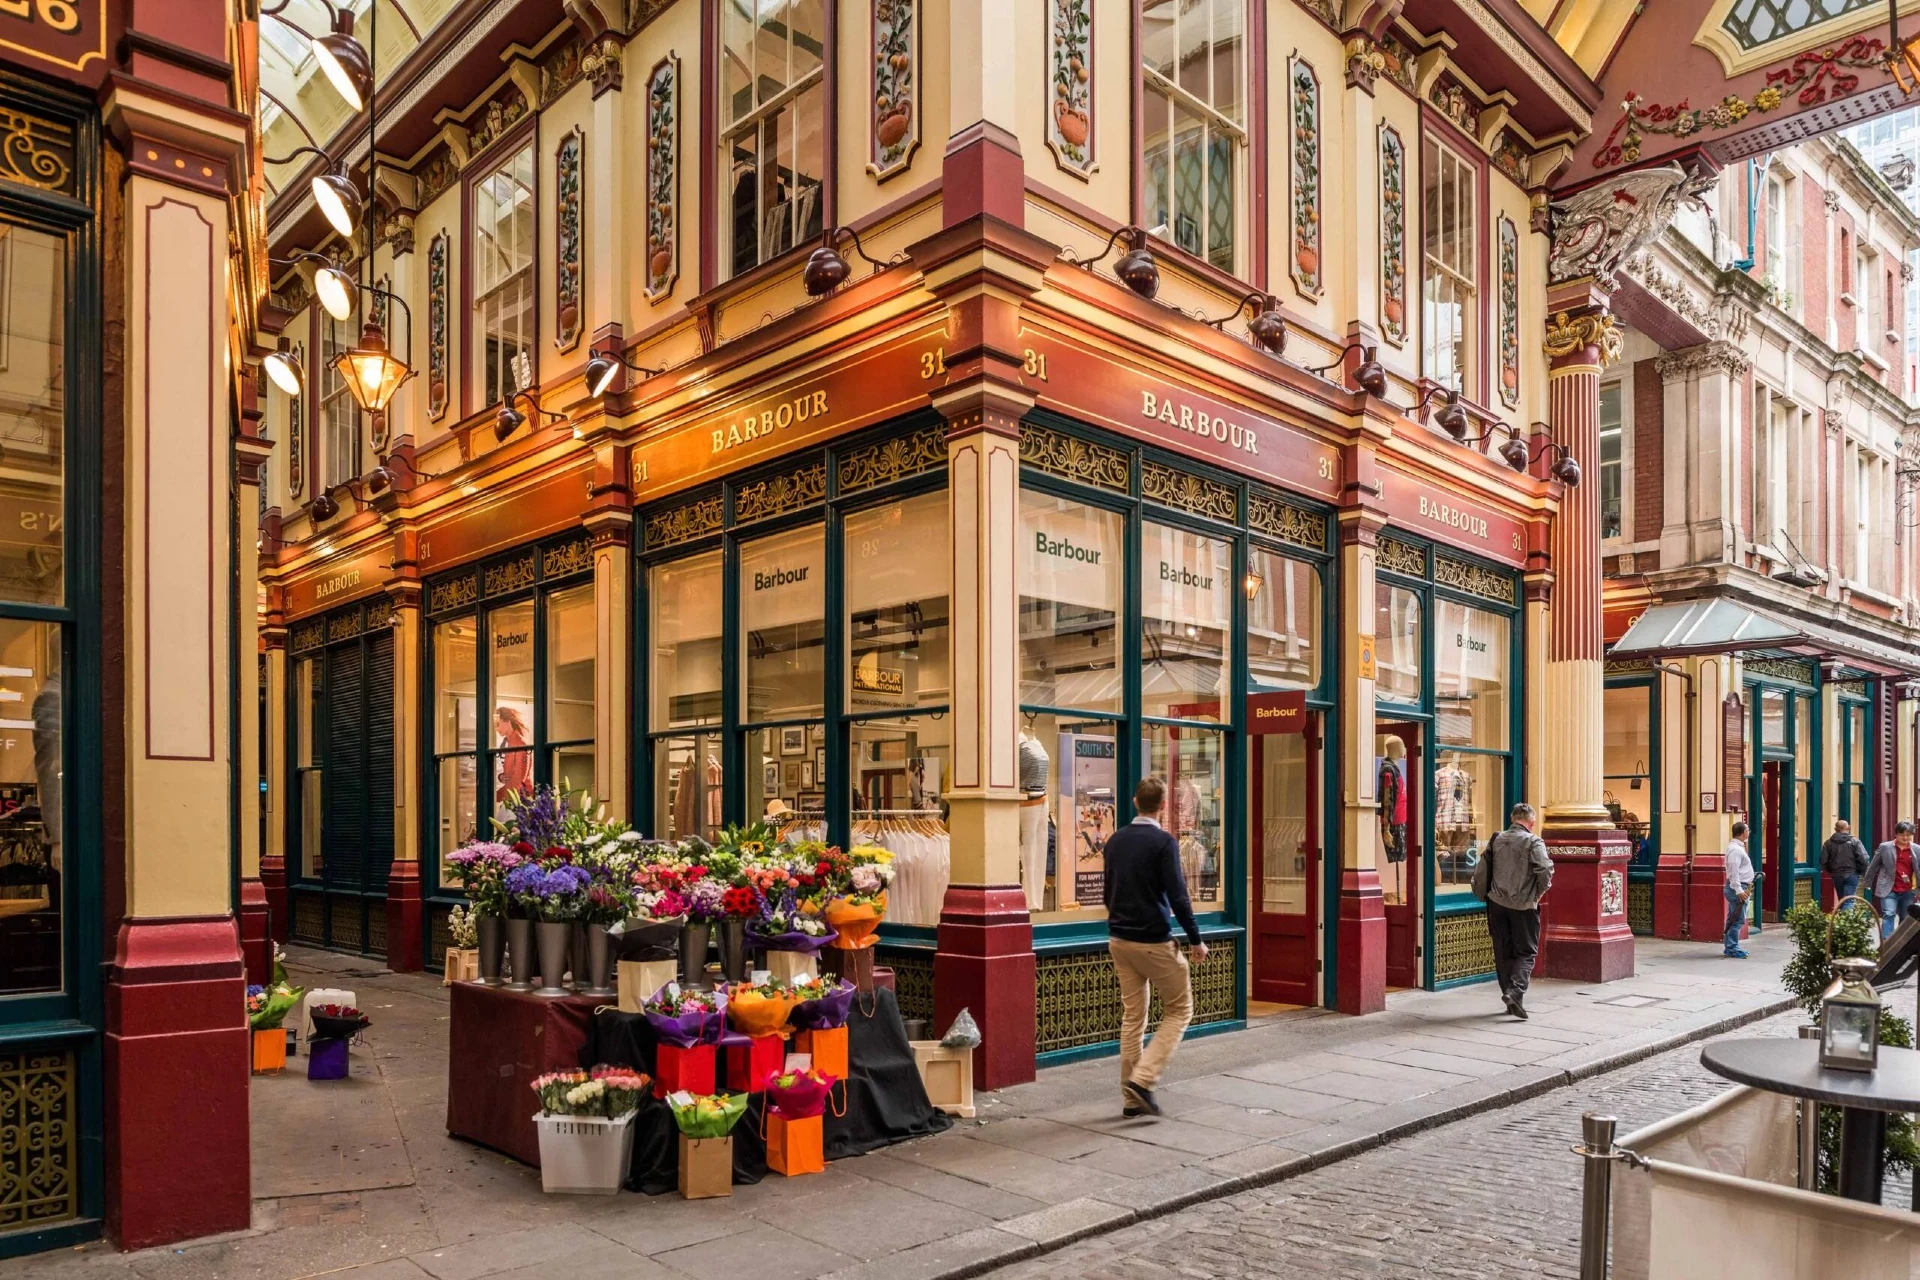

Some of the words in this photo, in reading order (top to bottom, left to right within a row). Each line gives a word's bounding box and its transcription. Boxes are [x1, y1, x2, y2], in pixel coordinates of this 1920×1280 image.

[920, 347, 946, 379] 31
[1024, 348, 1047, 382] 31
[711, 389, 830, 454] BARBOUR
[1141, 390, 1259, 455] BARBOUR
[634, 460, 648, 483] 31
[1318, 456, 1334, 481] 31
[1419, 495, 1489, 540] BARBOUR
[421, 543, 431, 560] 31
[1036, 531, 1101, 565] Barbour
[1512, 532, 1522, 551] 31
[316, 569, 361, 599] BARBOUR
[754, 566, 809, 592] Barbour
[1160, 561, 1213, 591] Barbour
[285, 597, 293, 609] 31
[497, 632, 528, 648] Barbour
[1457, 633, 1487, 652] Barbour
[853, 680, 902, 692] INTERNATIONAL
[855, 669, 901, 684] BARBOUR
[1256, 707, 1298, 718] Barbour
[1076, 741, 1102, 756] SOUTH
